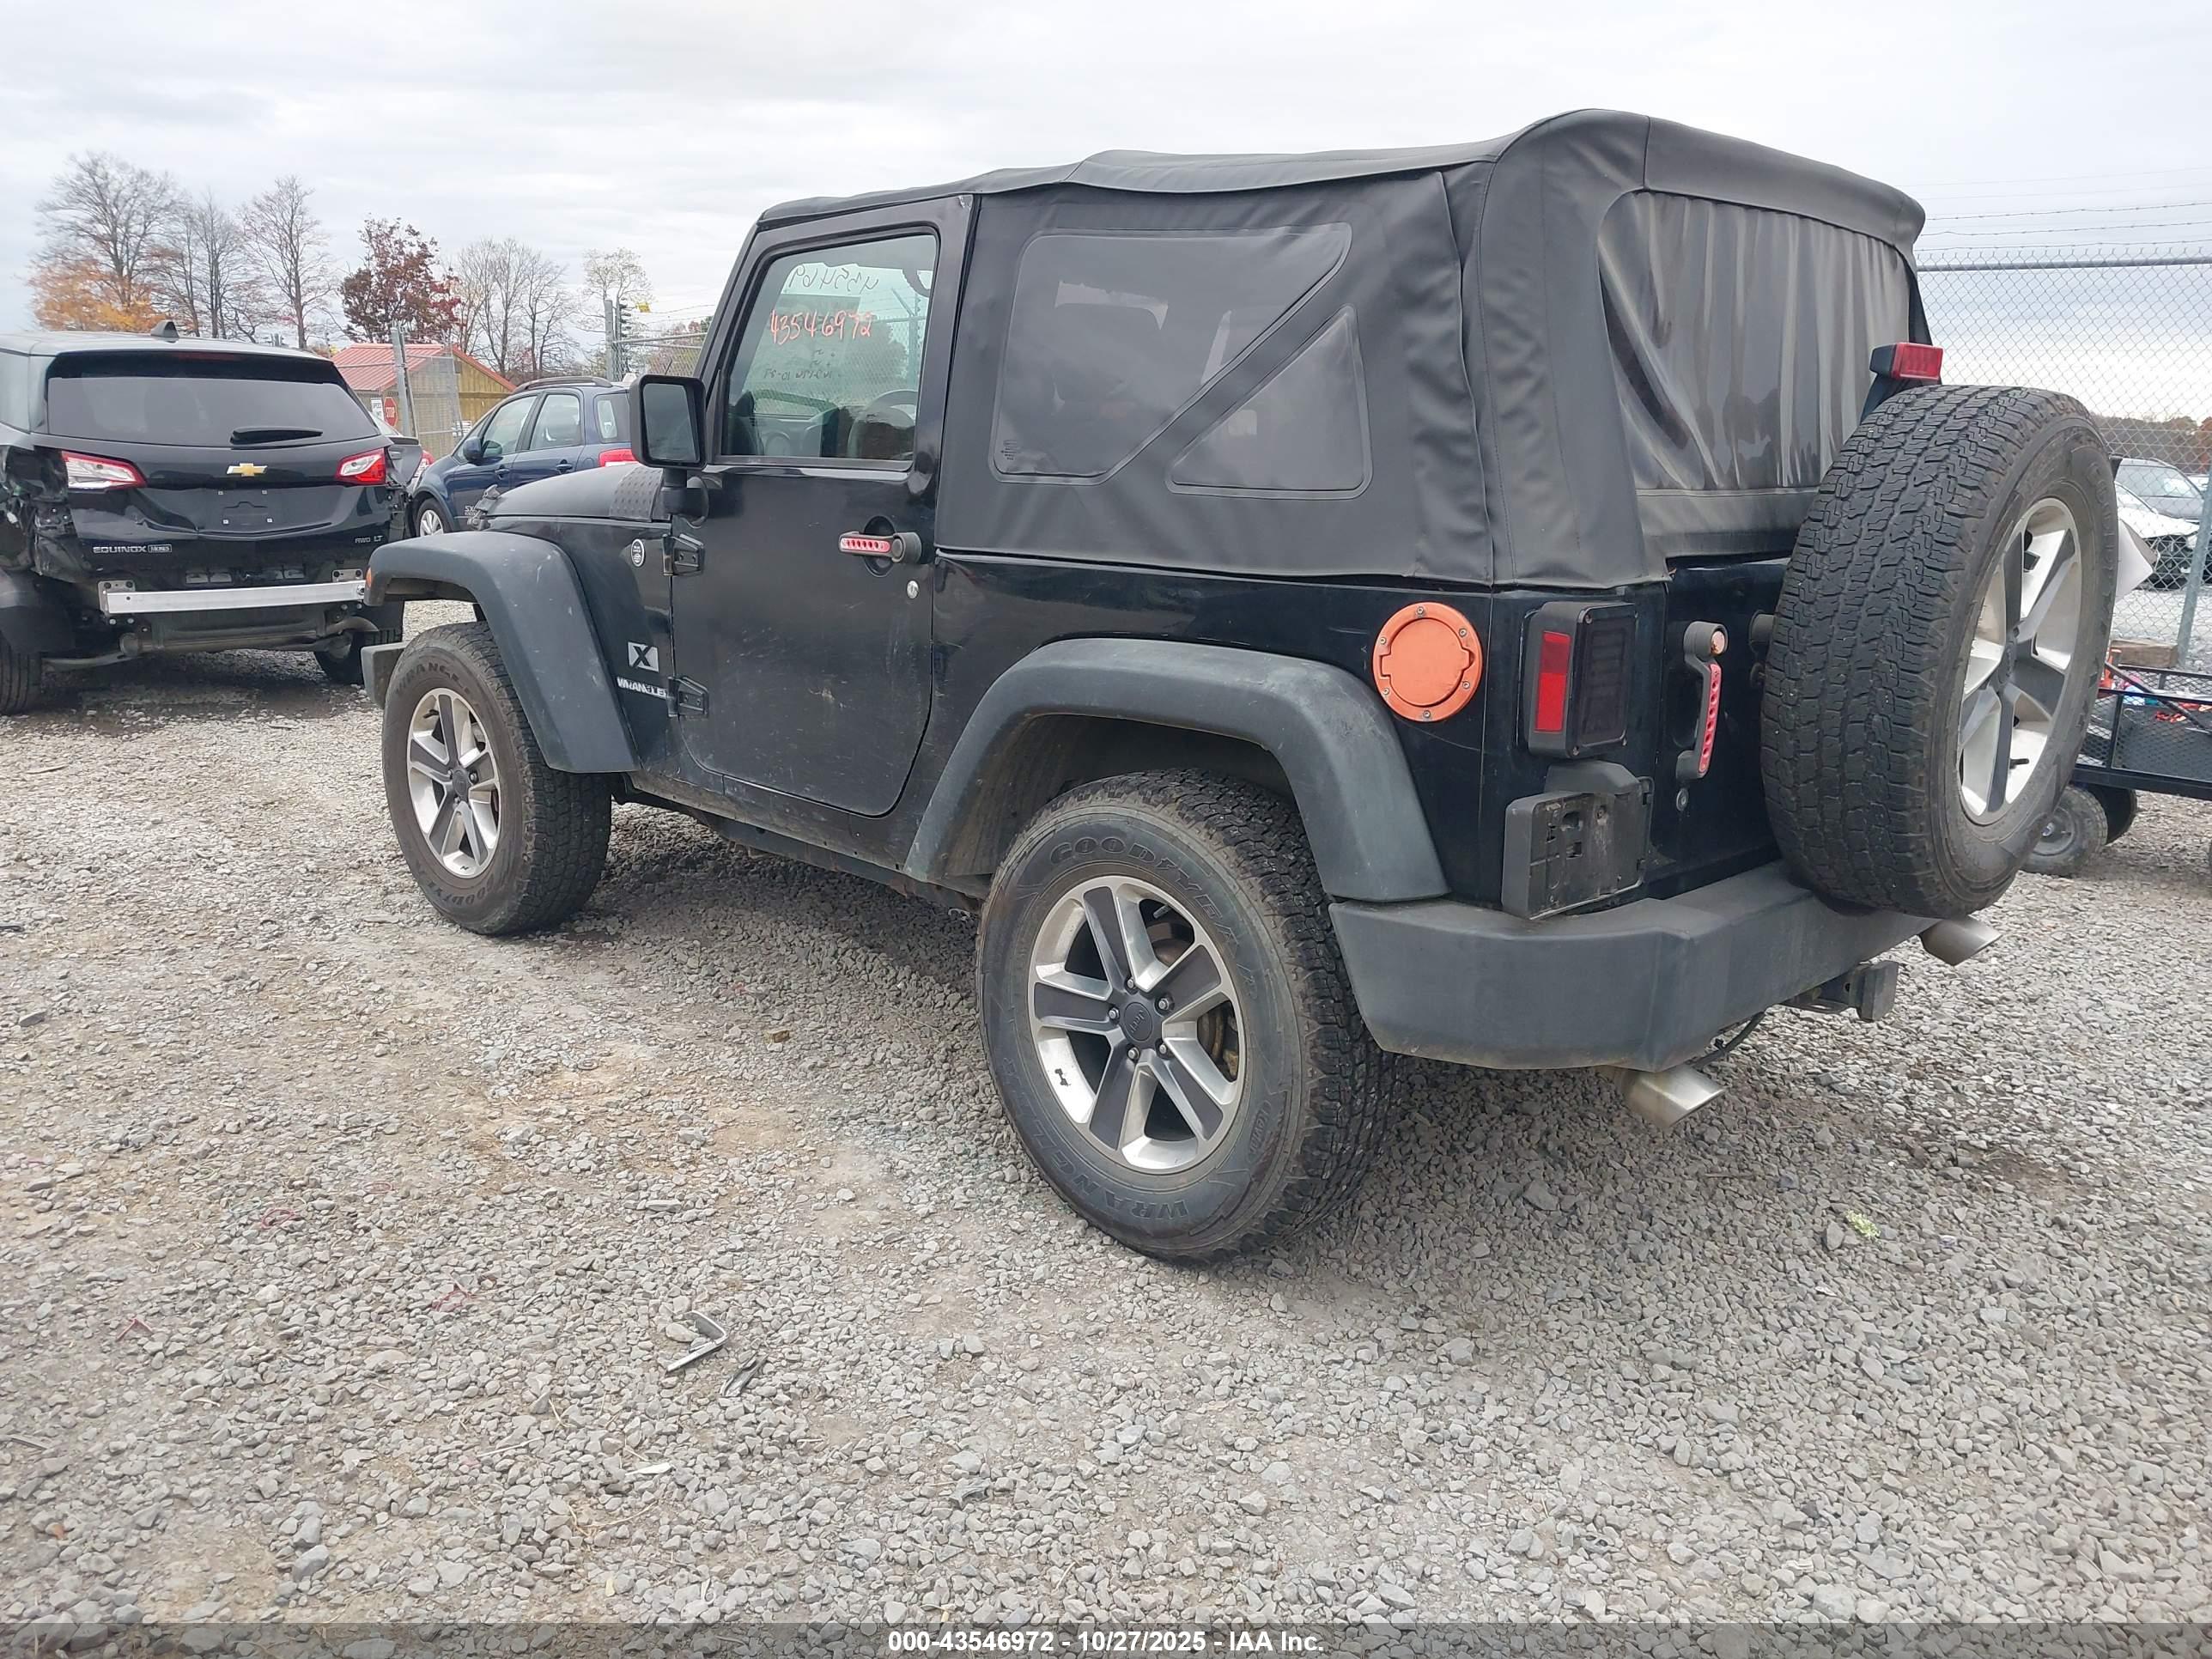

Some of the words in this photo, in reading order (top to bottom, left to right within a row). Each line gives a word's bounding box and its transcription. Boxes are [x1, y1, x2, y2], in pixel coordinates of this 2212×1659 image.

[770, 310, 873, 345] 43546972
[93, 545, 147, 554] EQUINOX
[1049, 836, 1259, 1000] GOODYEAR
